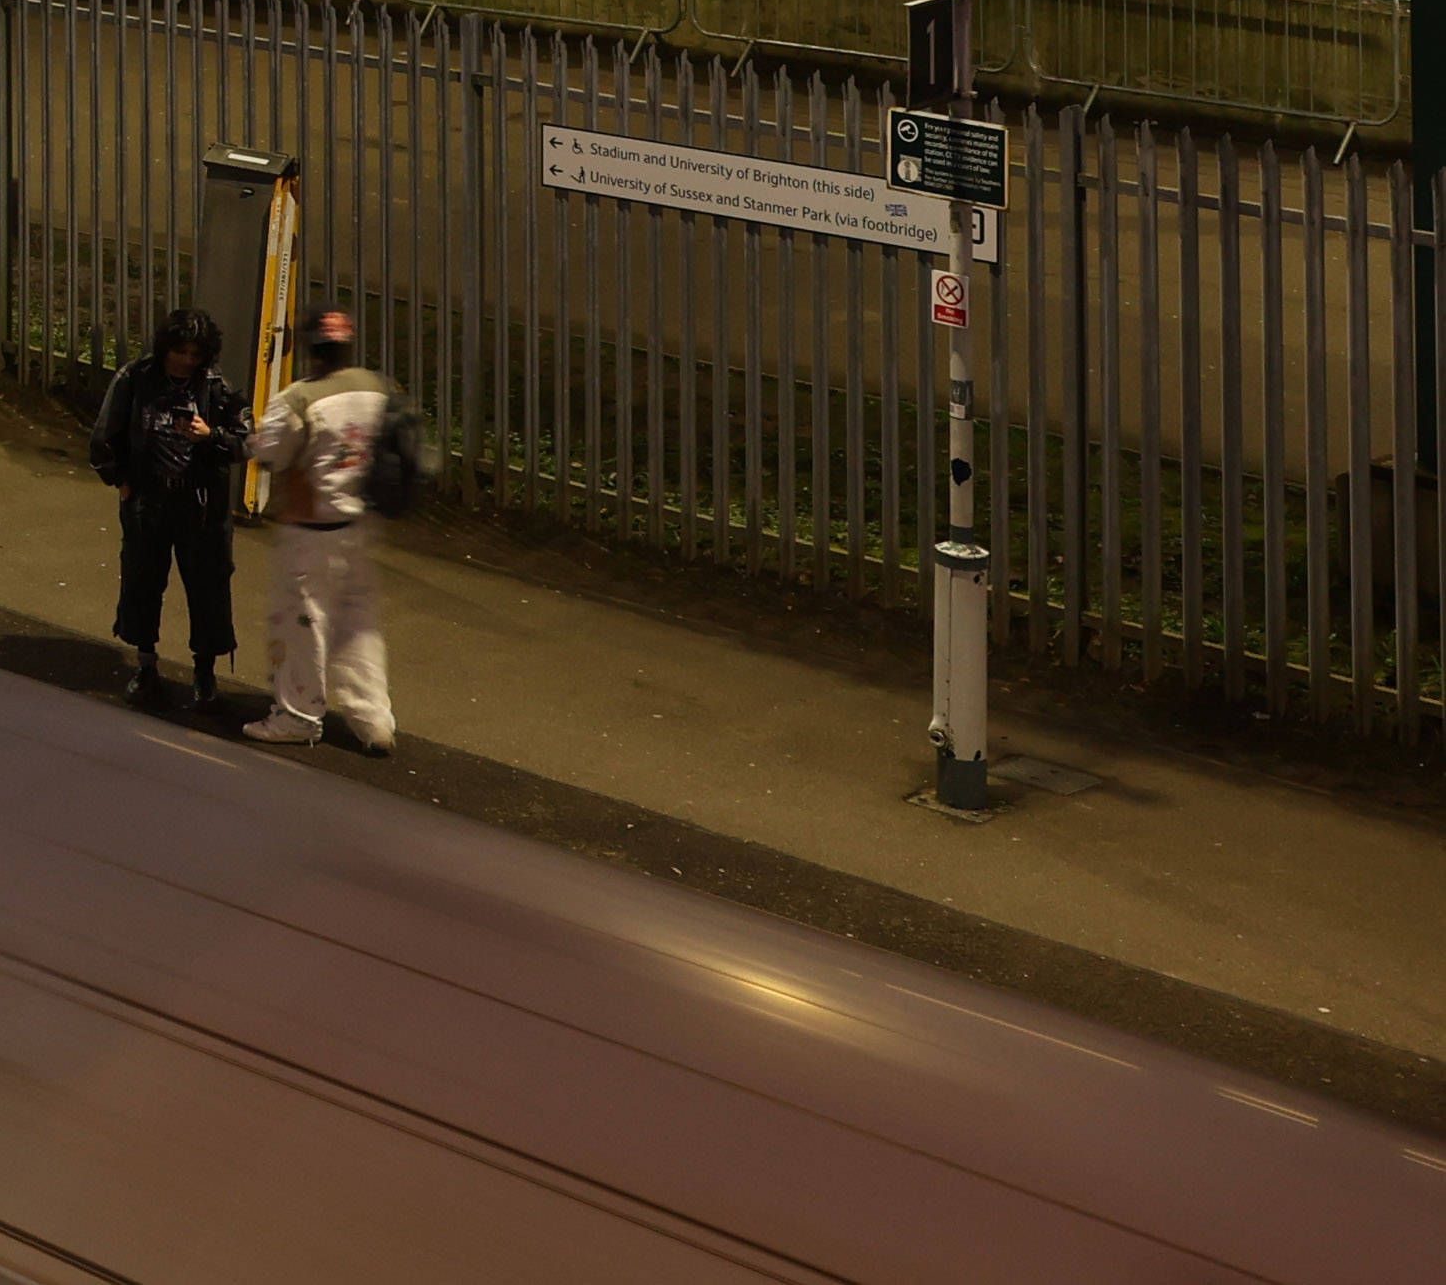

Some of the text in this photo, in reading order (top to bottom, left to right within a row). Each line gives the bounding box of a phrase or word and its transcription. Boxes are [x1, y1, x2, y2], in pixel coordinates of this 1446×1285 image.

[926, 18, 936, 85] 1
[590, 142, 875, 202] Stadium and University of Brighton (this side)
[590, 170, 937, 243] University of Sussex and Stanmer Park (via footbridge)
